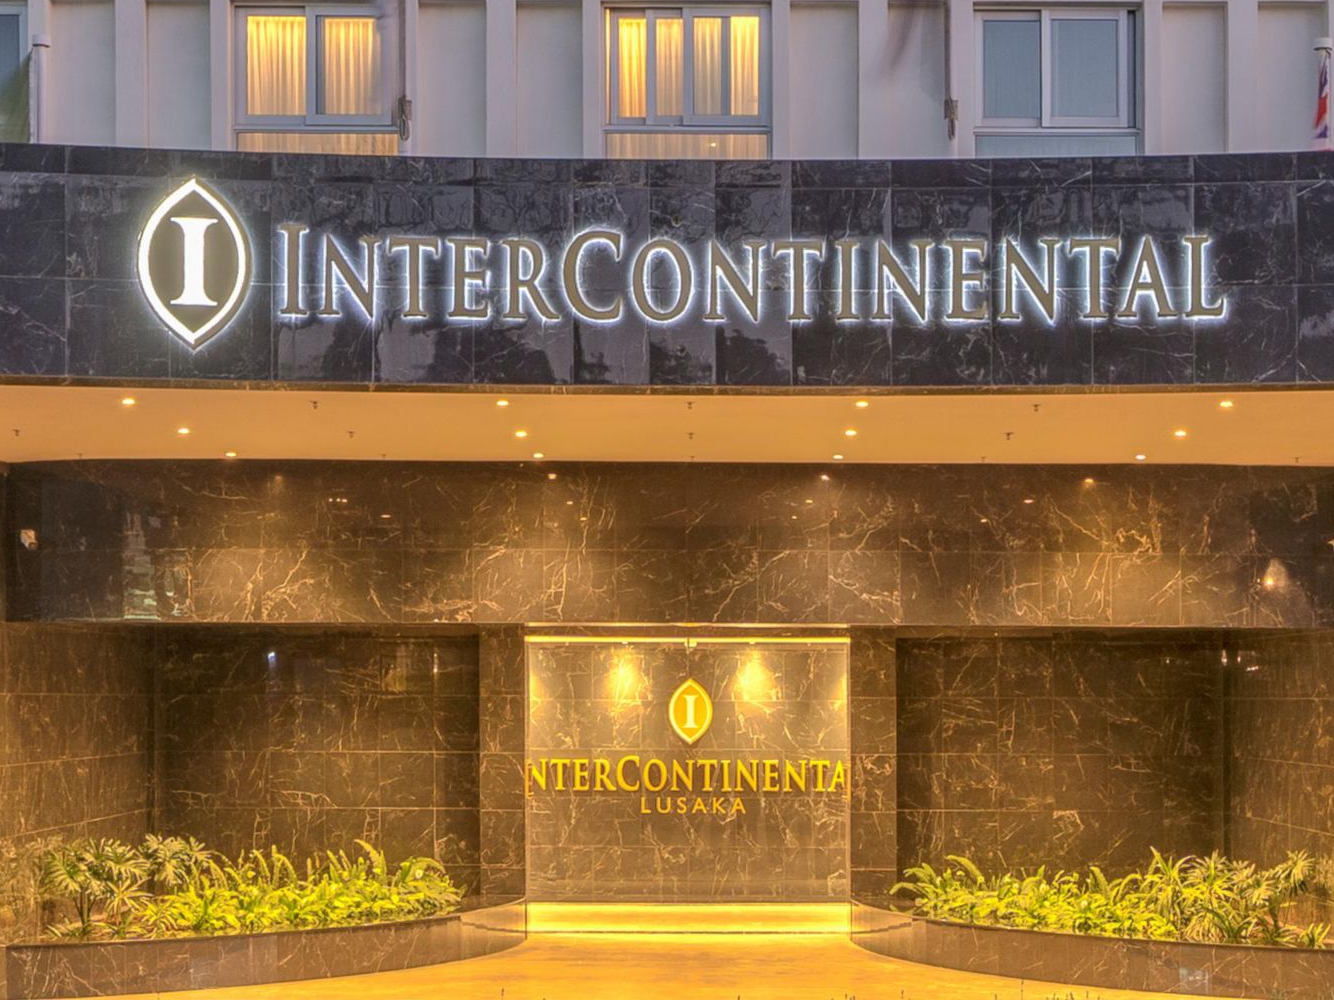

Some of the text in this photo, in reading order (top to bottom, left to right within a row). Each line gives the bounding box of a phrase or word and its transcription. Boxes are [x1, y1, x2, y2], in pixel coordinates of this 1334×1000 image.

[170, 217, 218, 306] I
[277, 223, 1227, 322] INTERCONTINENTAL
[531, 755, 845, 793] NTERCONTINENTA
[640, 796, 747, 814] LUSAKA
